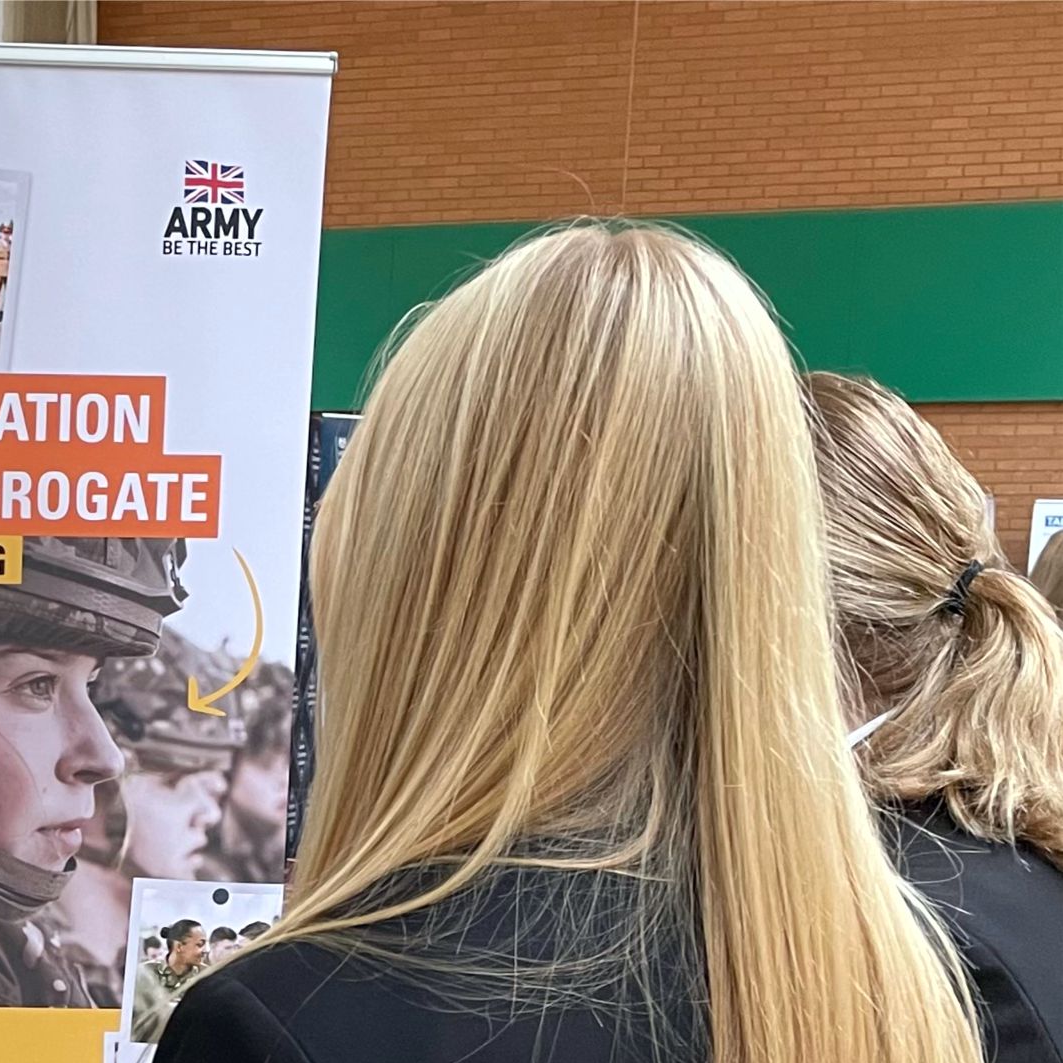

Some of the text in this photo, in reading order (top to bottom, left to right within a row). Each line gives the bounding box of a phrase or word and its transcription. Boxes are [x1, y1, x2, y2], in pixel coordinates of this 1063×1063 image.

[164, 207, 263, 239] ARMY
[163, 241, 261, 256] BE THE BEST
